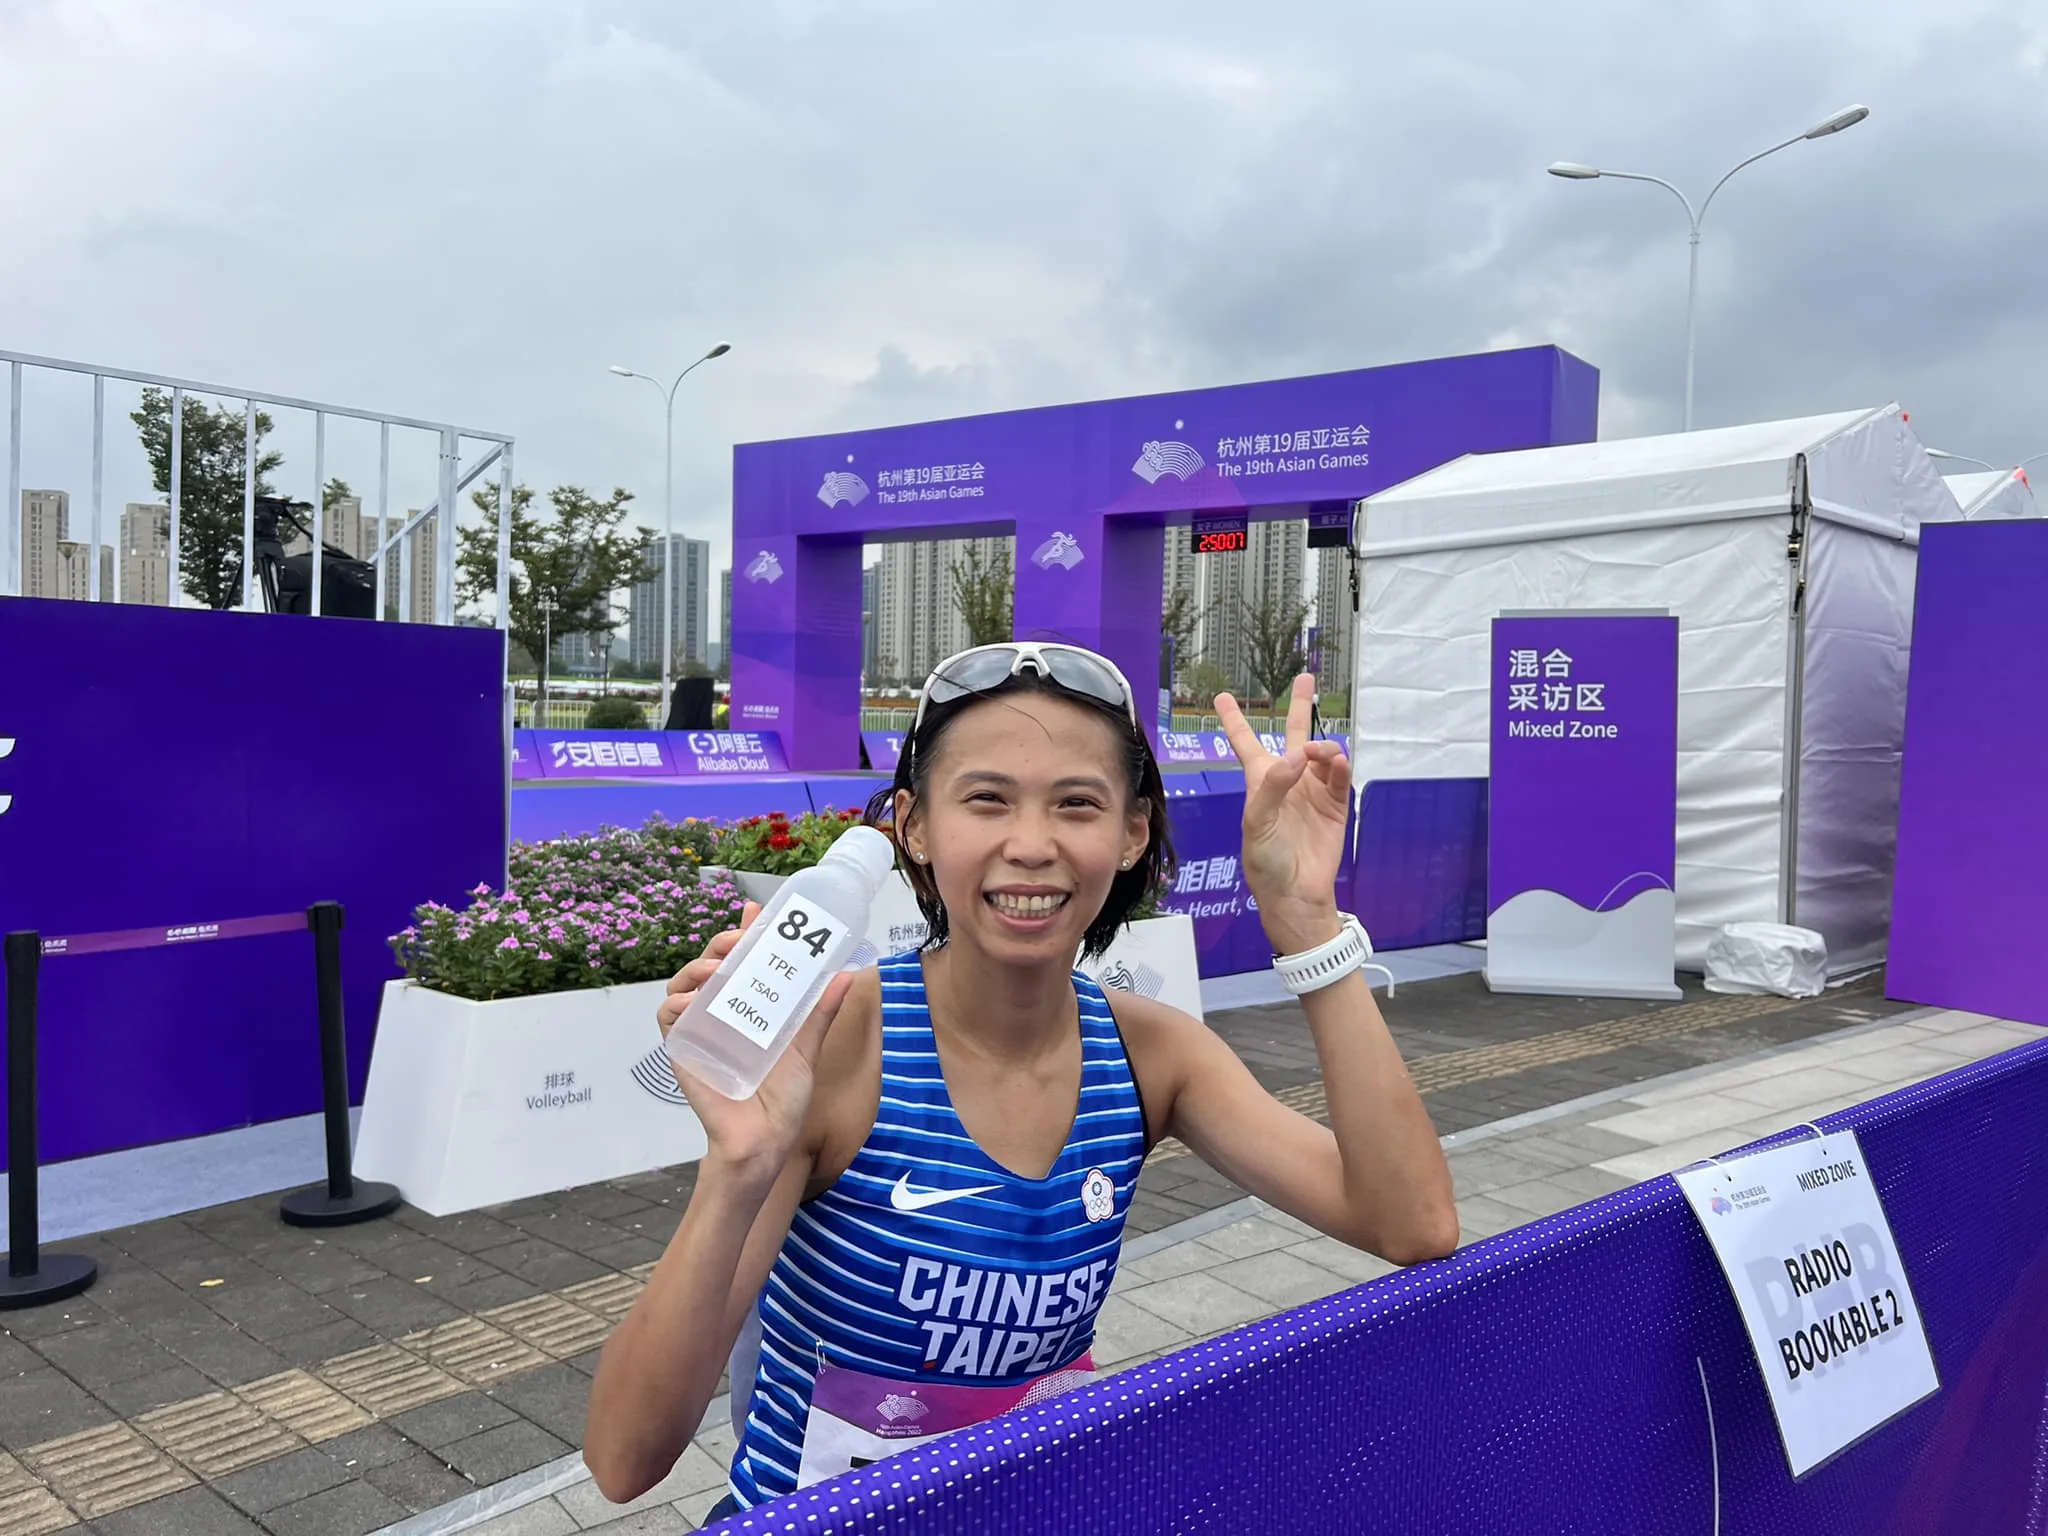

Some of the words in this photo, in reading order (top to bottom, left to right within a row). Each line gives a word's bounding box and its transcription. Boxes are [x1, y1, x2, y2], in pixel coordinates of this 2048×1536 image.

[1217, 424, 1370, 458] 杭州第19届亚运会
[878, 461, 985, 487] 杭州第19届亚运会
[1217, 463, 1241, 477] The
[1245, 460, 1274, 475] 19th
[1277, 457, 1315, 472] Asian
[1319, 453, 1369, 469] Games
[878, 491, 896, 504] The
[897, 488, 918, 502] 19th
[920, 487, 947, 500] Asian
[949, 485, 984, 499] Games
[1508, 648, 1573, 678] 混合
[1508, 682, 1606, 712] 采访区
[1508, 720, 1565, 738] Mixed
[1569, 721, 1618, 738] Zone
[717, 733, 763, 753] 阿里云
[698, 755, 738, 771] Alibaba
[738, 755, 769, 771] Cloud
[1188, 897, 1241, 918] Heart,
[778, 910, 832, 958] 84
[767, 953, 798, 980] TPE
[750, 977, 780, 1003] TSAO
[727, 997, 769, 1032] 40Km
[545, 1072, 574, 1090] 排球
[527, 1088, 592, 1110] Volleyball
[1796, 1165, 1830, 1193] MIXED
[1827, 1160, 1857, 1184] ZONE
[1784, 1239, 1852, 1298] RADIO
[898, 1255, 1108, 1328] CHINESE
[1778, 1294, 1890, 1380] BOOKABLE
[1885, 1288, 1904, 1327] 2
[921, 1320, 1073, 1377] TAIPEI
